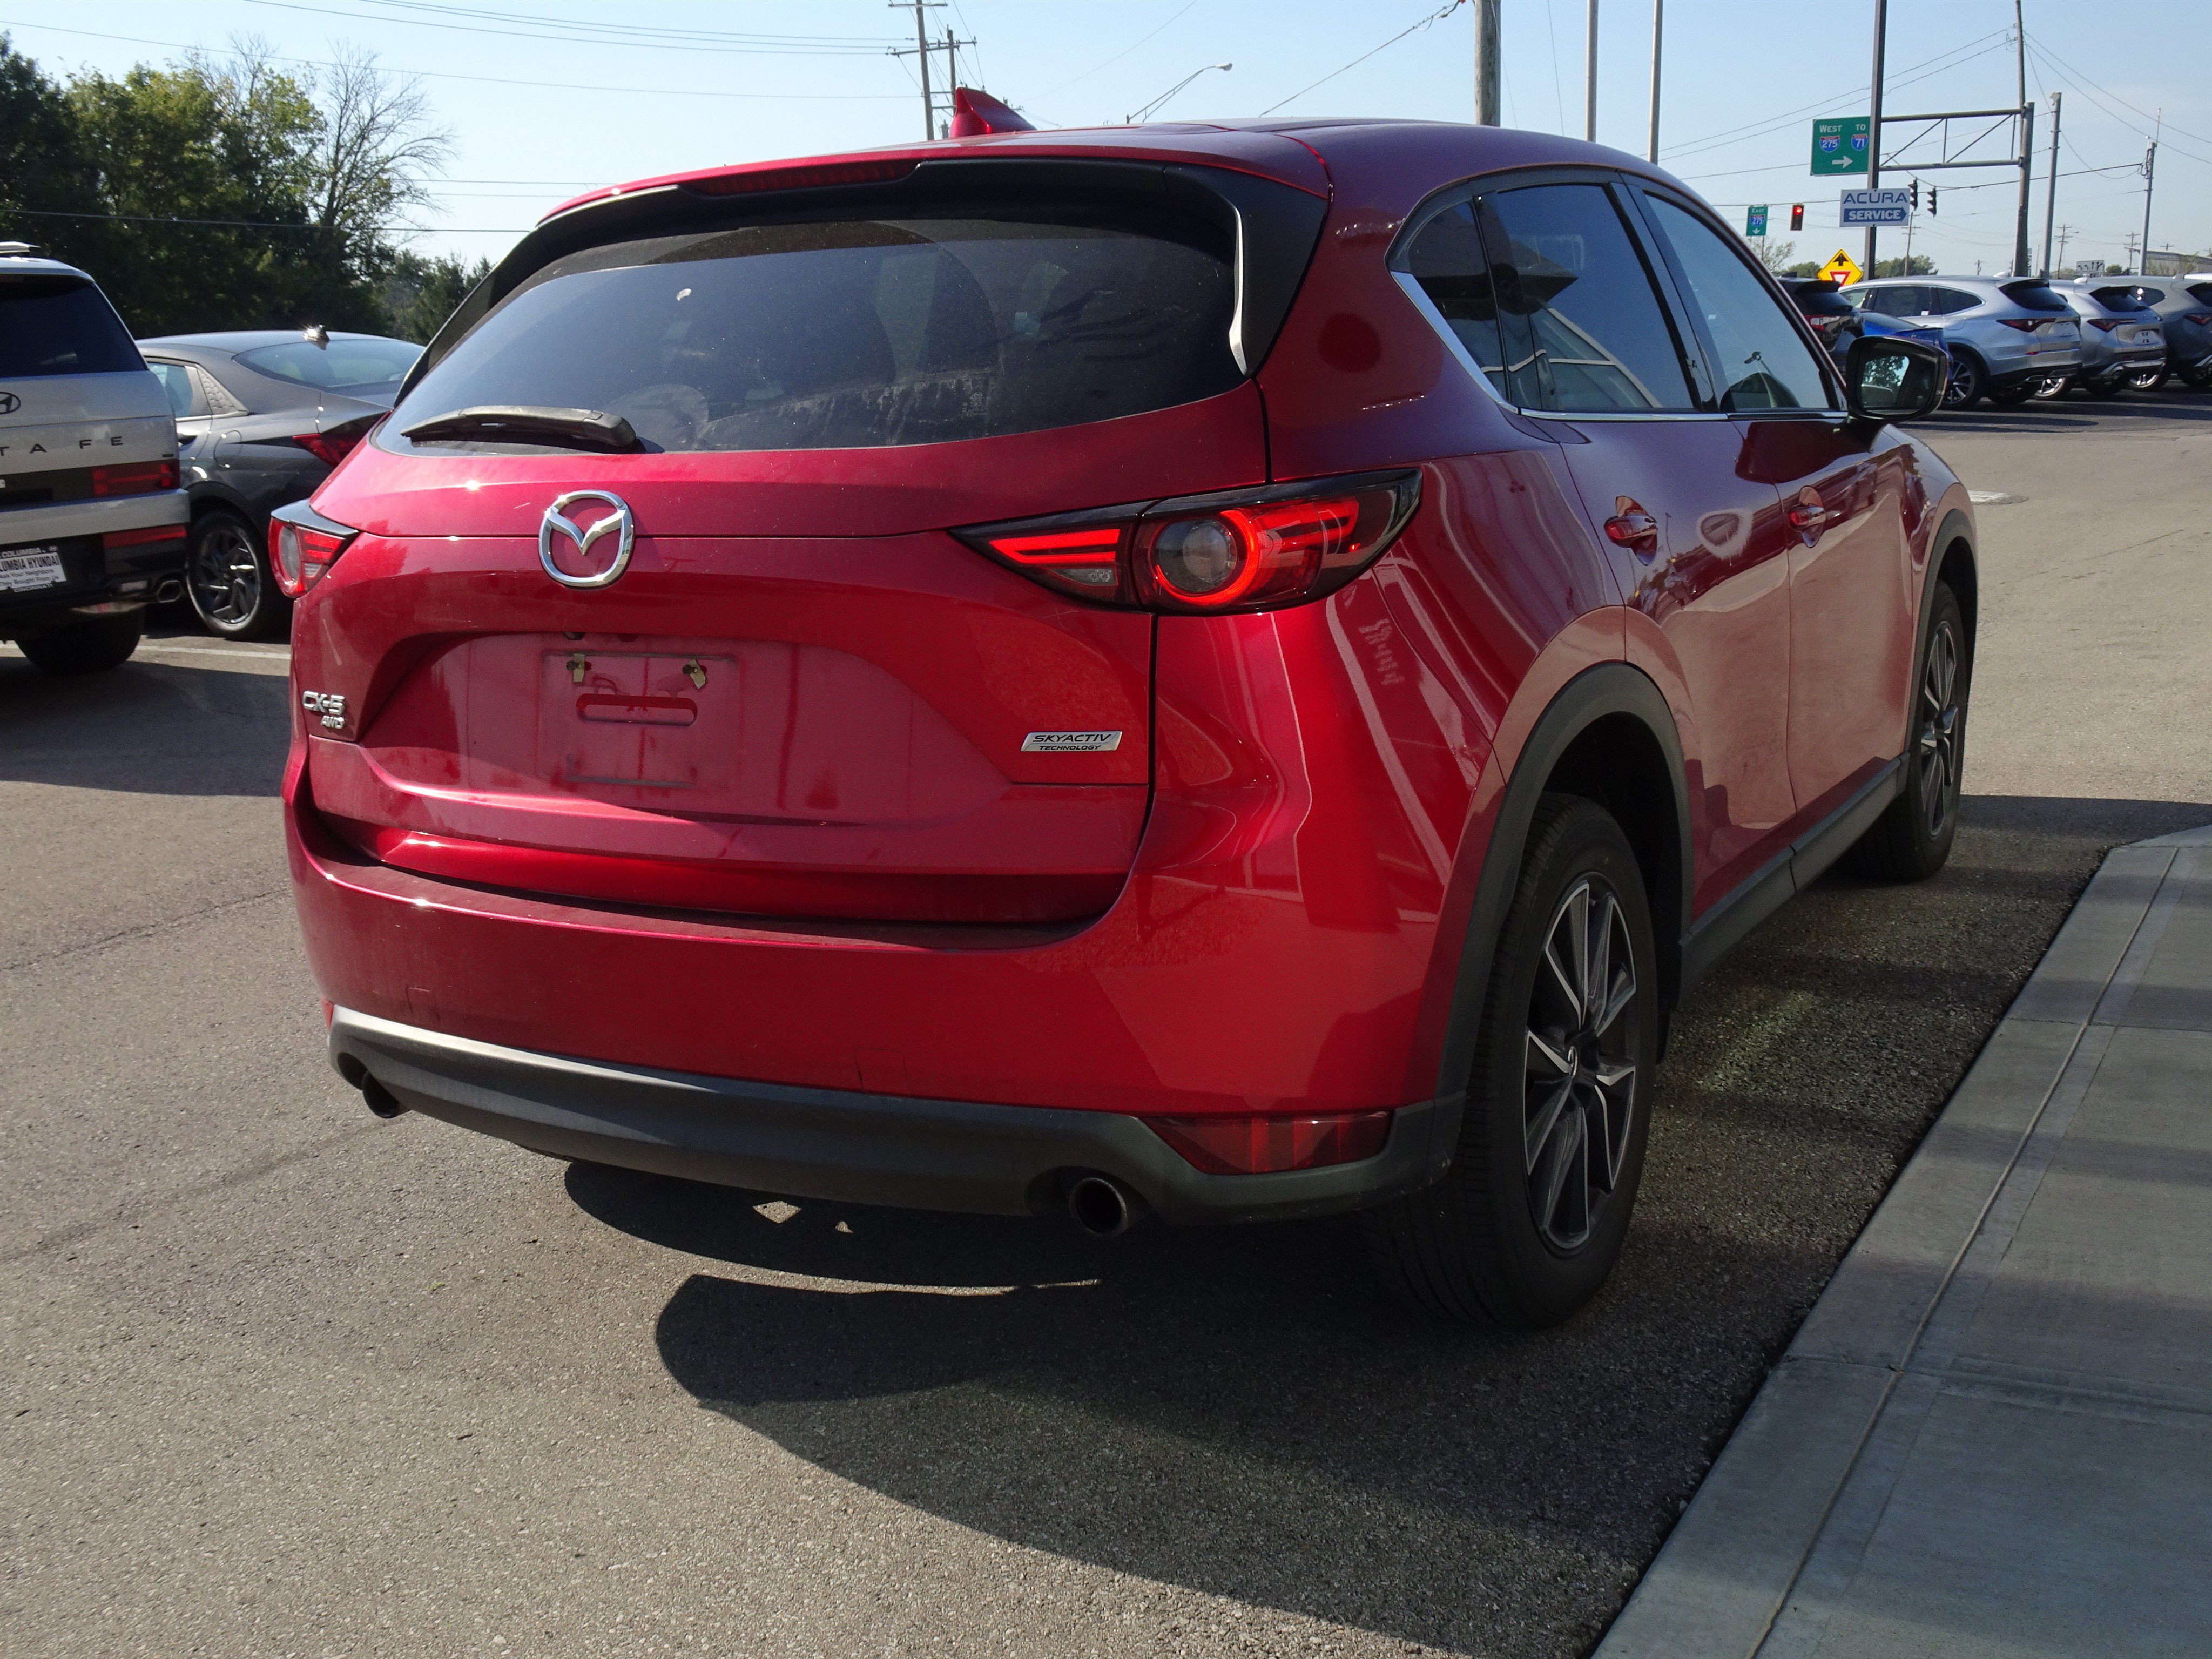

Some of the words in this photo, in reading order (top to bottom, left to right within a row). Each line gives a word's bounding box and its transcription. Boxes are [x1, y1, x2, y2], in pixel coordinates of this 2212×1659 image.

[1819, 125, 1843, 133] WEST
[1822, 139, 1838, 149] 275
[1855, 138, 1865, 148] 71
[1843, 192, 1908, 204] ACURA
[1752, 217, 1763, 225] 275
[1848, 209, 1901, 221] SERVICE
[79, 436, 124, 449] FE
[27, 555, 60, 569] HYUNDAI
[302, 691, 345, 716] CX-5
[320, 715, 345, 729] AWD
[1033, 734, 1112, 743] SKYACTIV
